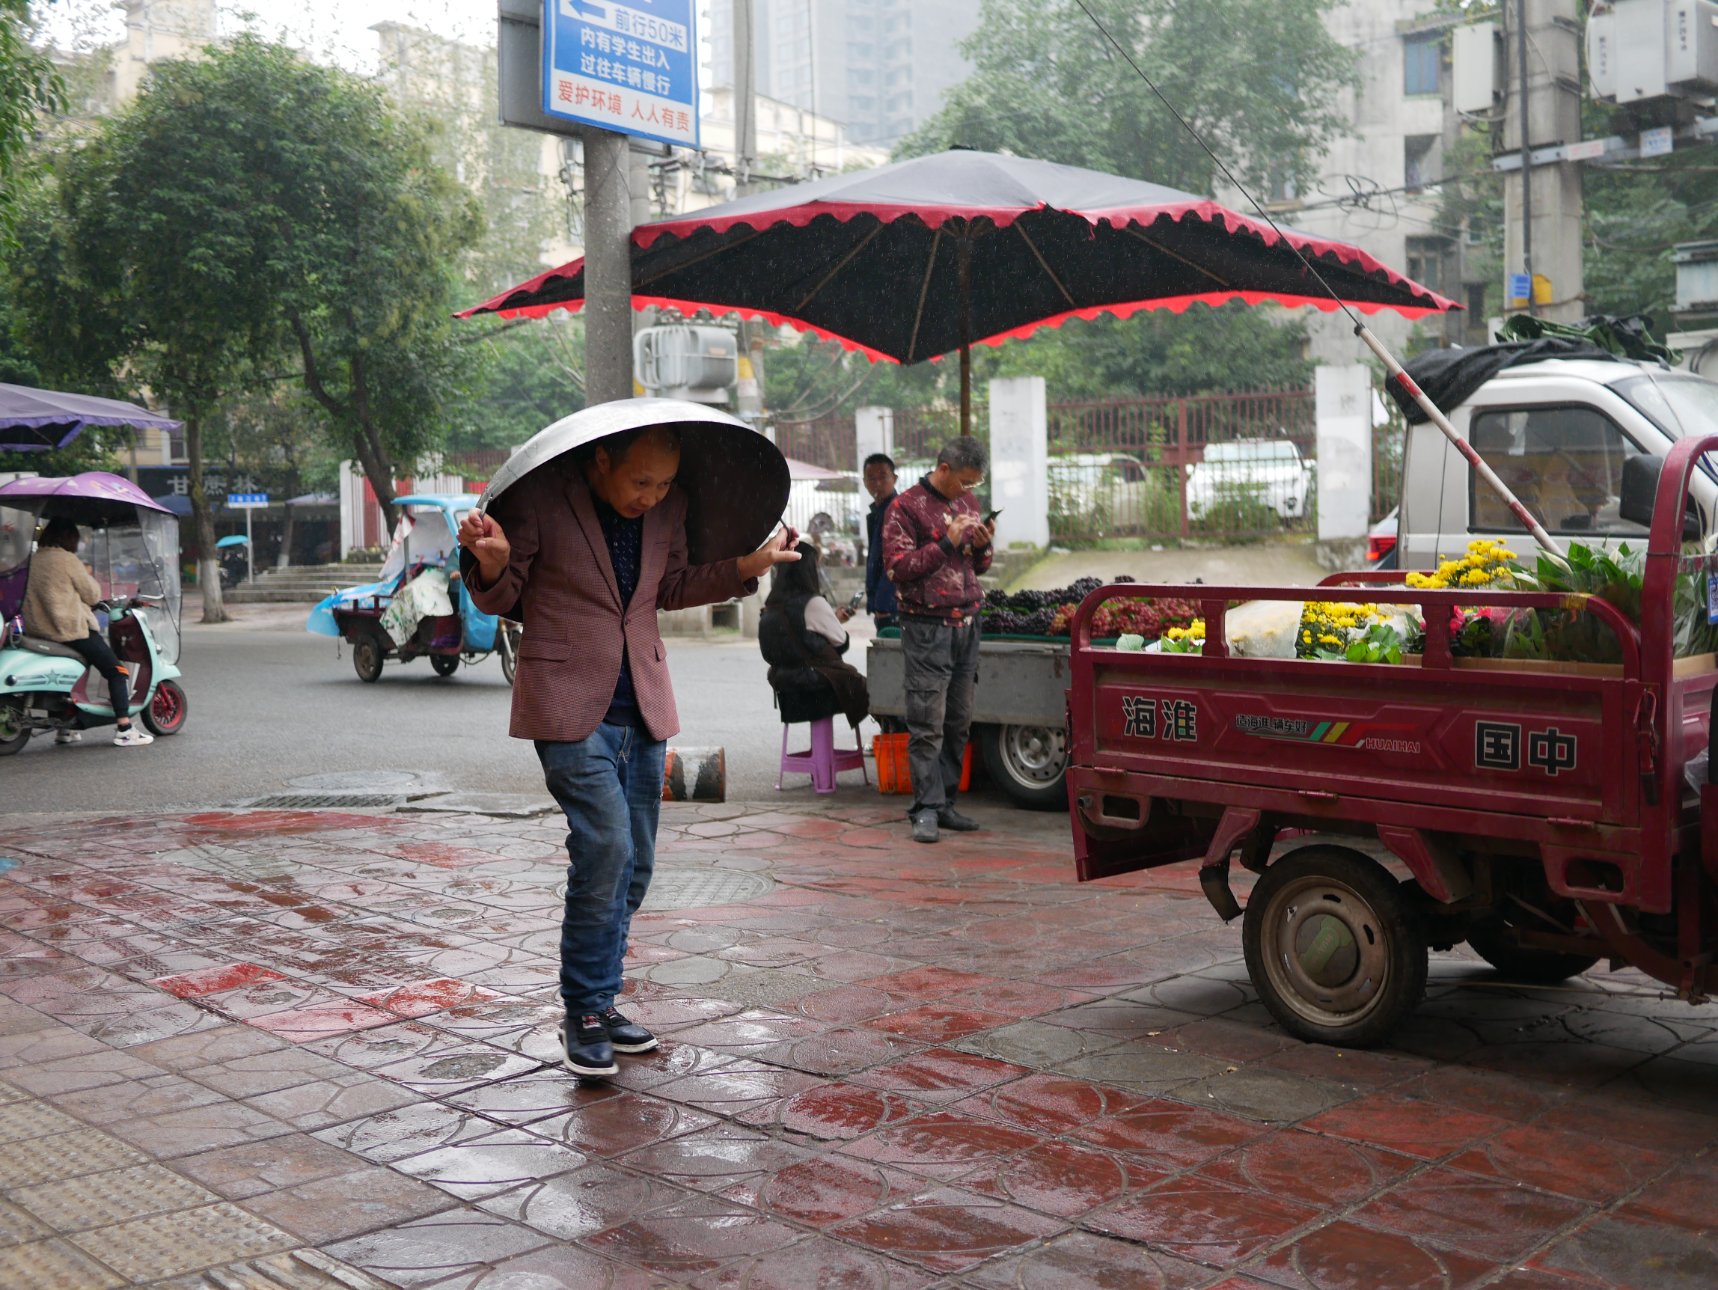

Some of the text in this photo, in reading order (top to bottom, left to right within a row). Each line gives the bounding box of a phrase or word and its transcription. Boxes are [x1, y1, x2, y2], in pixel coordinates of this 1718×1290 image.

[580, 27, 671, 71] 内有学生出入
[614, 8, 684, 47] 前行50米
[580, 52, 671, 96] 过往车辆慢行
[558, 79, 690, 132] 爱护环境 人人有责
[1365, 737, 1421, 754] HUAIHAI
